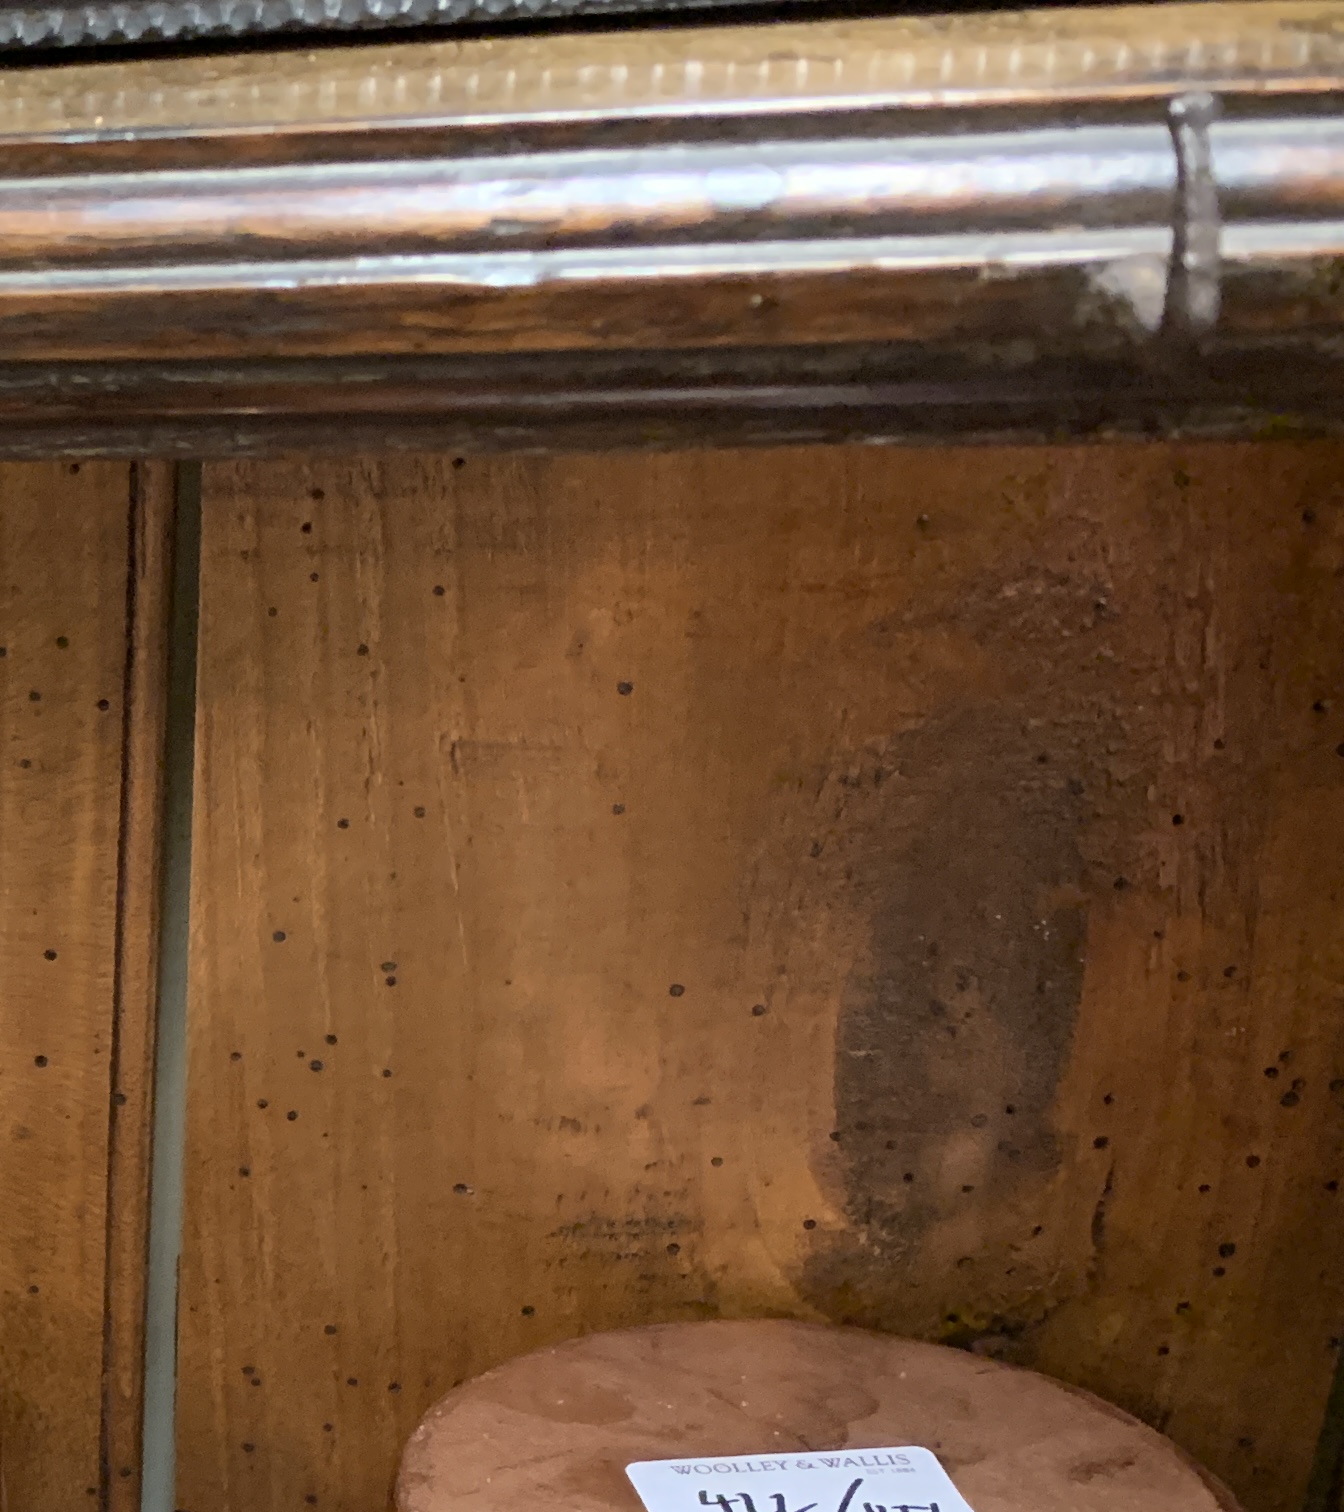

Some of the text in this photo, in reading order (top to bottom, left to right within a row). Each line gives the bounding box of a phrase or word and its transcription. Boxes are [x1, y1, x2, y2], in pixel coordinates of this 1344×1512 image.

[670, 1454, 912, 1476] WOOLLEY & WALLIS
